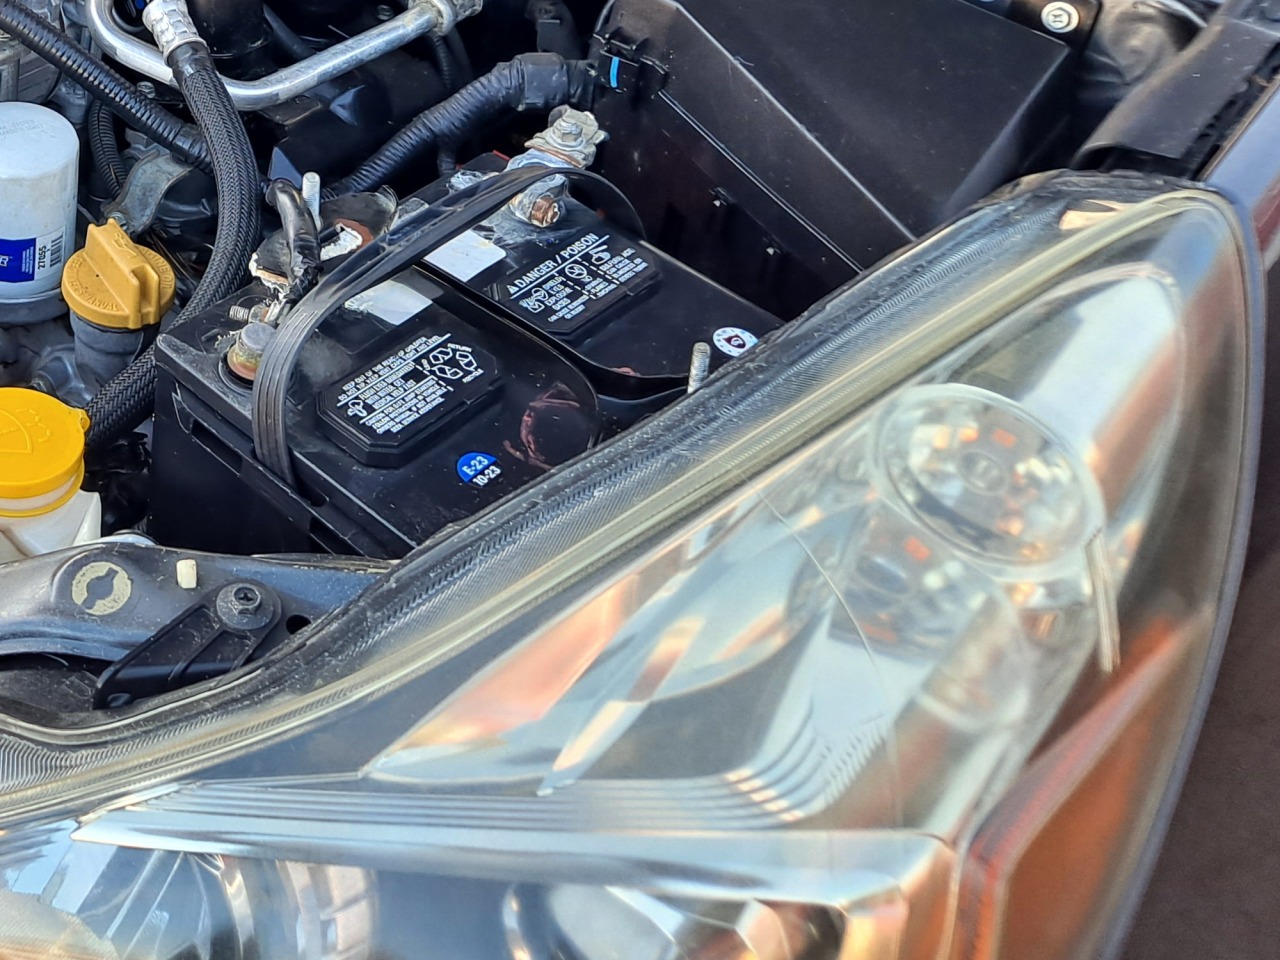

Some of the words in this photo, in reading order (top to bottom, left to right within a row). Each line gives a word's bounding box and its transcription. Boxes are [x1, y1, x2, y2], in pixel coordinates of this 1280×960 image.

[514, 259, 557, 287] DANGER
[560, 233, 599, 258] POISON
[461, 456, 489, 476] E-23
[472, 465, 501, 486] 10-23
